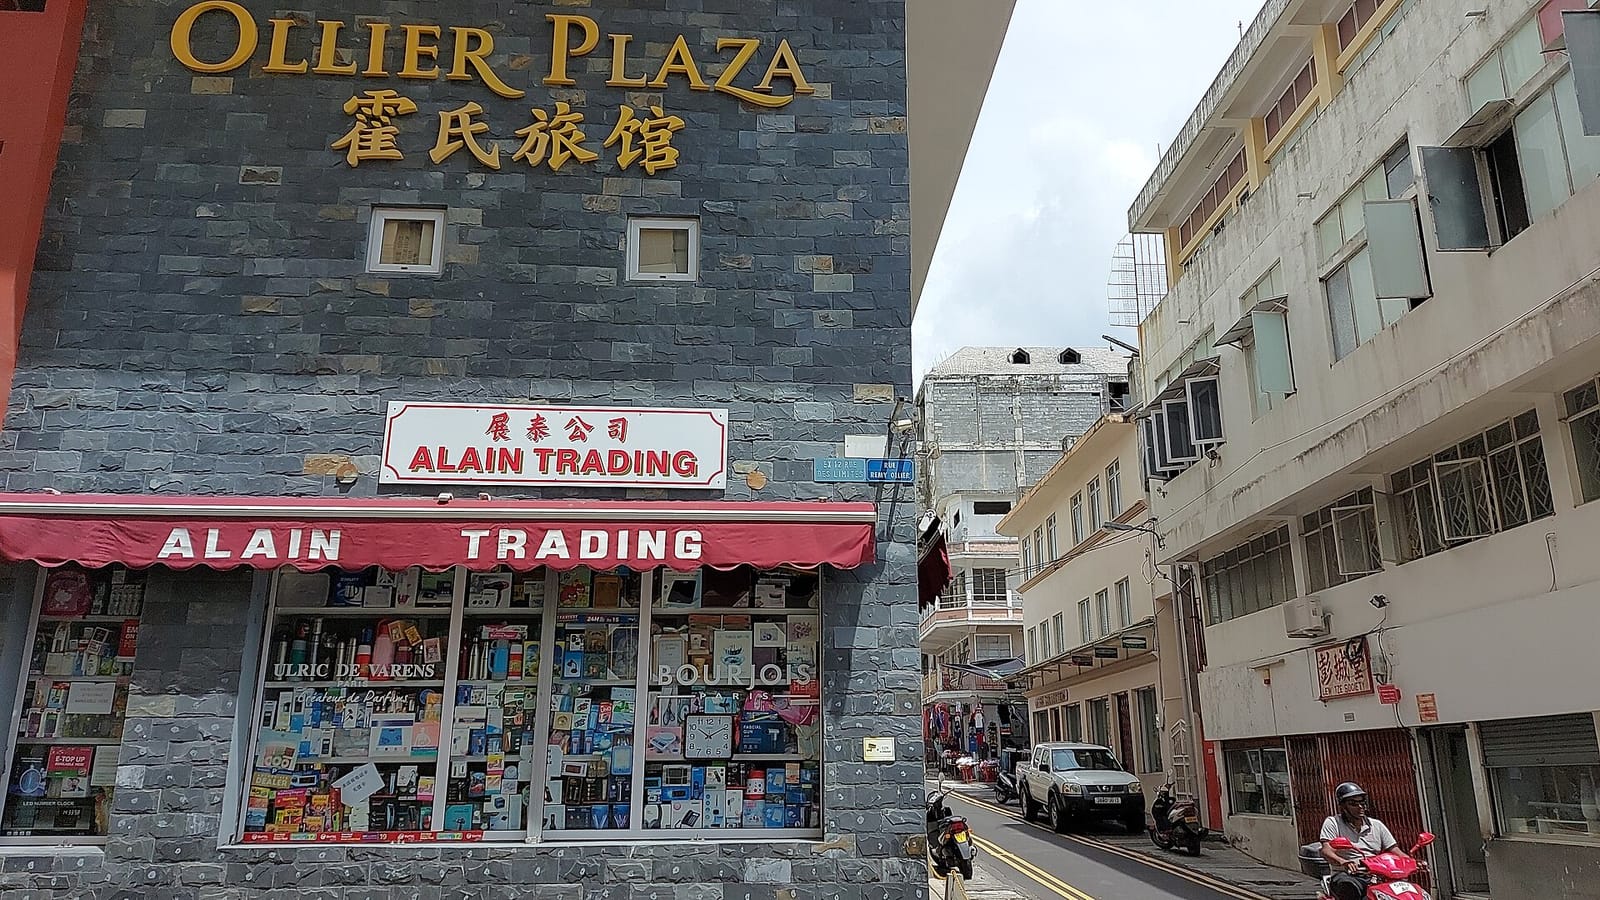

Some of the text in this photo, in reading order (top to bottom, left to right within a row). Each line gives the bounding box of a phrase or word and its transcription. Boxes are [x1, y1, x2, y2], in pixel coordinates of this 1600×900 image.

[169, 0, 816, 108] OLLIER PLAZA
[331, 88, 686, 175] 霍氏旅馆
[485, 411, 628, 443] 展泰公司
[408, 445, 699, 479] ALAIN TRADING
[883, 461, 896, 469] RUE
[156, 527, 704, 561] ALAIN TRADING
[273, 663, 435, 678] ULRIC DE VARENS
[658, 663, 811, 690] BOURJOIS
[336, 680, 369, 688] PARIS
[297, 690, 409, 706] Créateur de Parfums
[700, 692, 769, 700] PARIS
[255, 777, 288, 787] DEALER
